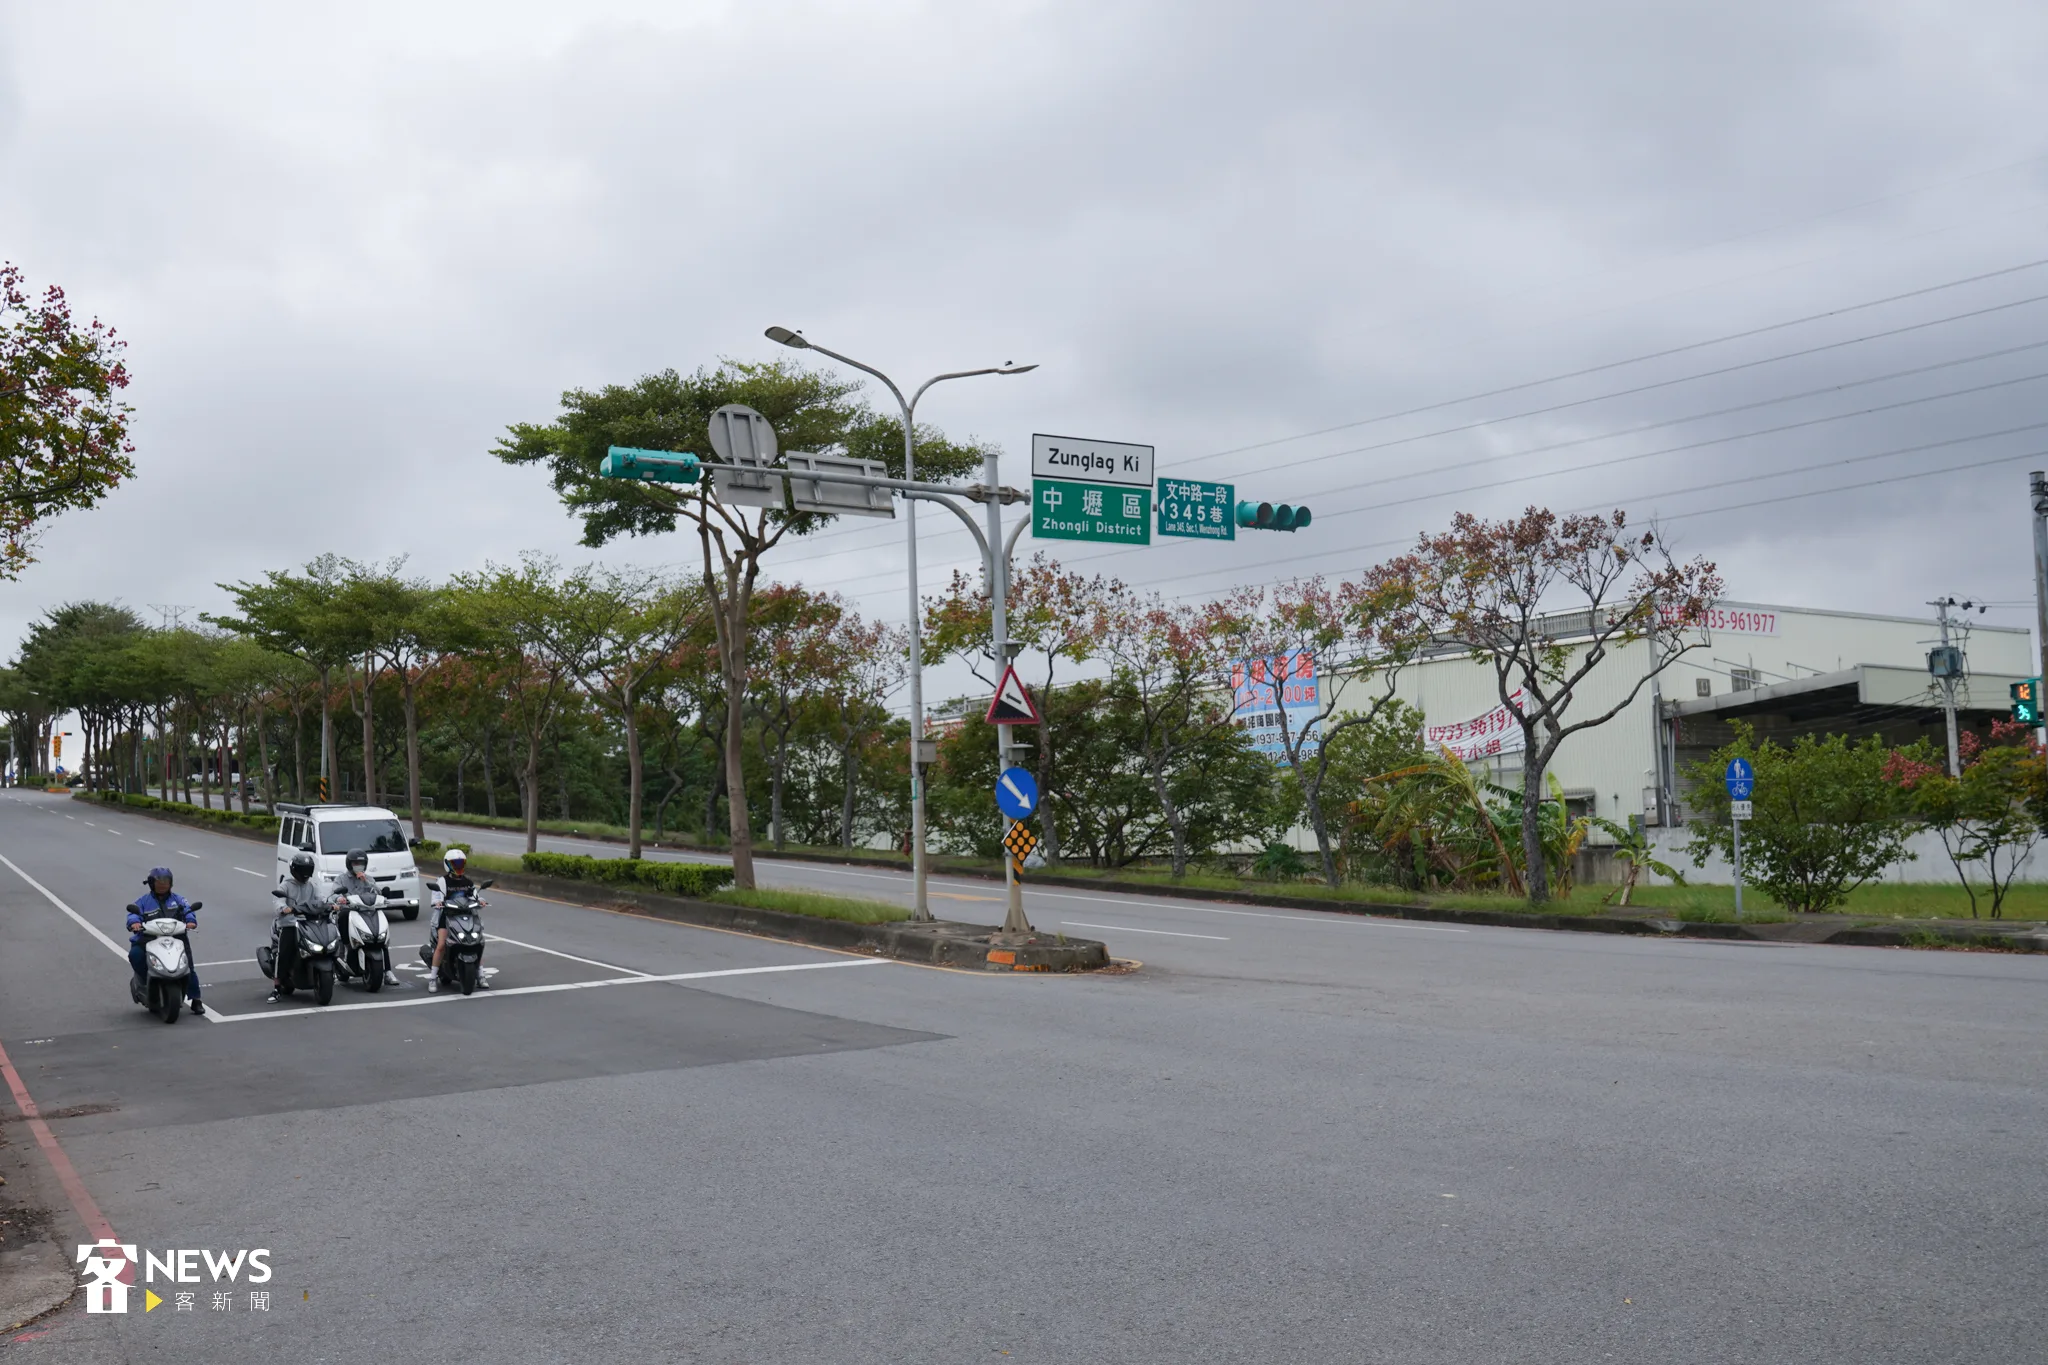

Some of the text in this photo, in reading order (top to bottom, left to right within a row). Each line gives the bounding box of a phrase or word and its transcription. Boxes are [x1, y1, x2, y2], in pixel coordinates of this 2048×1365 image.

[1048, 447, 1139, 474] Zunglag Ki
[1042, 486, 1142, 519] 中壢區
[1165, 481, 1227, 504] 文中路一段
[1042, 517, 1142, 536] Zhongli District
[1165, 521, 1176, 532] Lane
